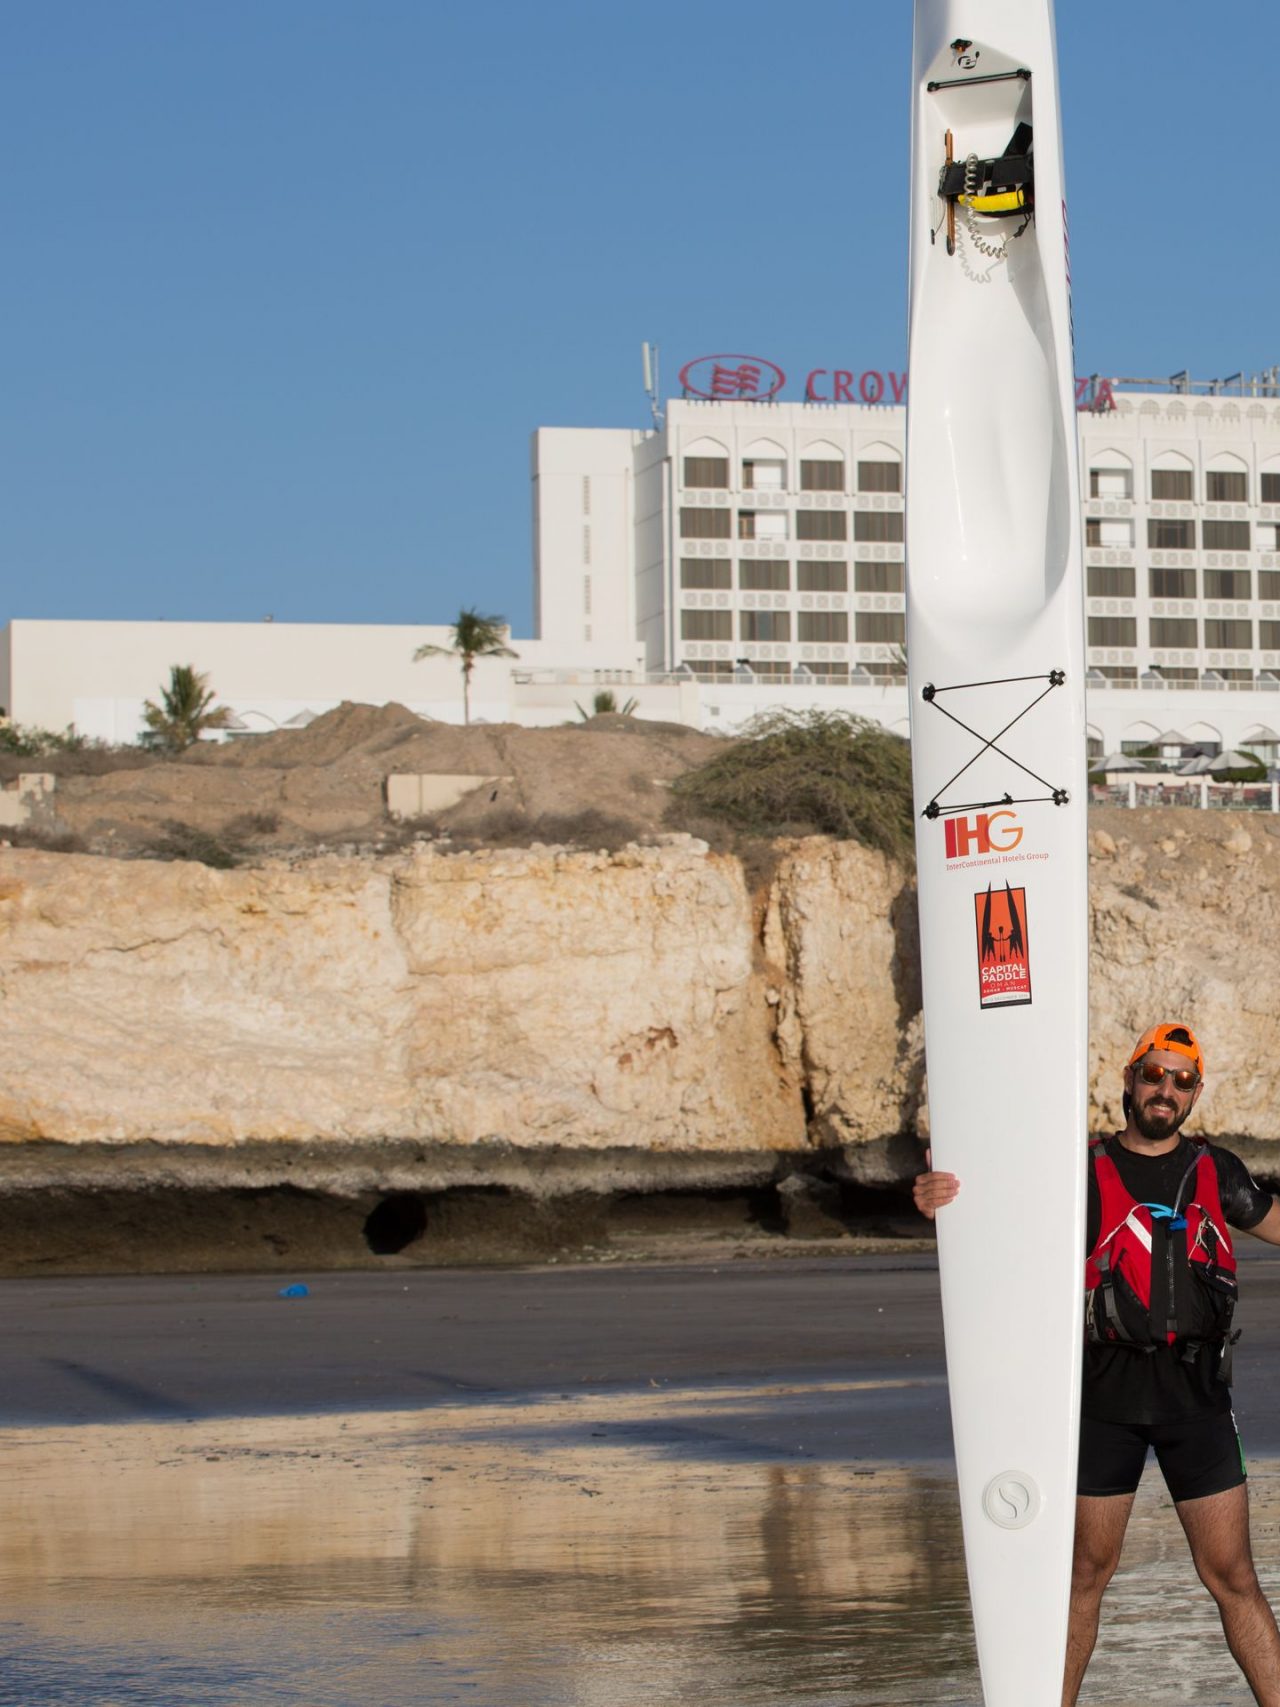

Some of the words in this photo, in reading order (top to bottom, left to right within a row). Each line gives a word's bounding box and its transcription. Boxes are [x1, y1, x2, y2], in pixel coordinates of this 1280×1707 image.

[806, 368, 908, 404] CROW
[944, 810, 1024, 859] IHG
[946, 856, 1001, 871] InterContinental
[1002, 853, 1025, 863] Hotels
[1026, 852, 1049, 861] Group
[981, 963, 1026, 975] CAPITAL
[982, 970, 1027, 984] PADDLE
